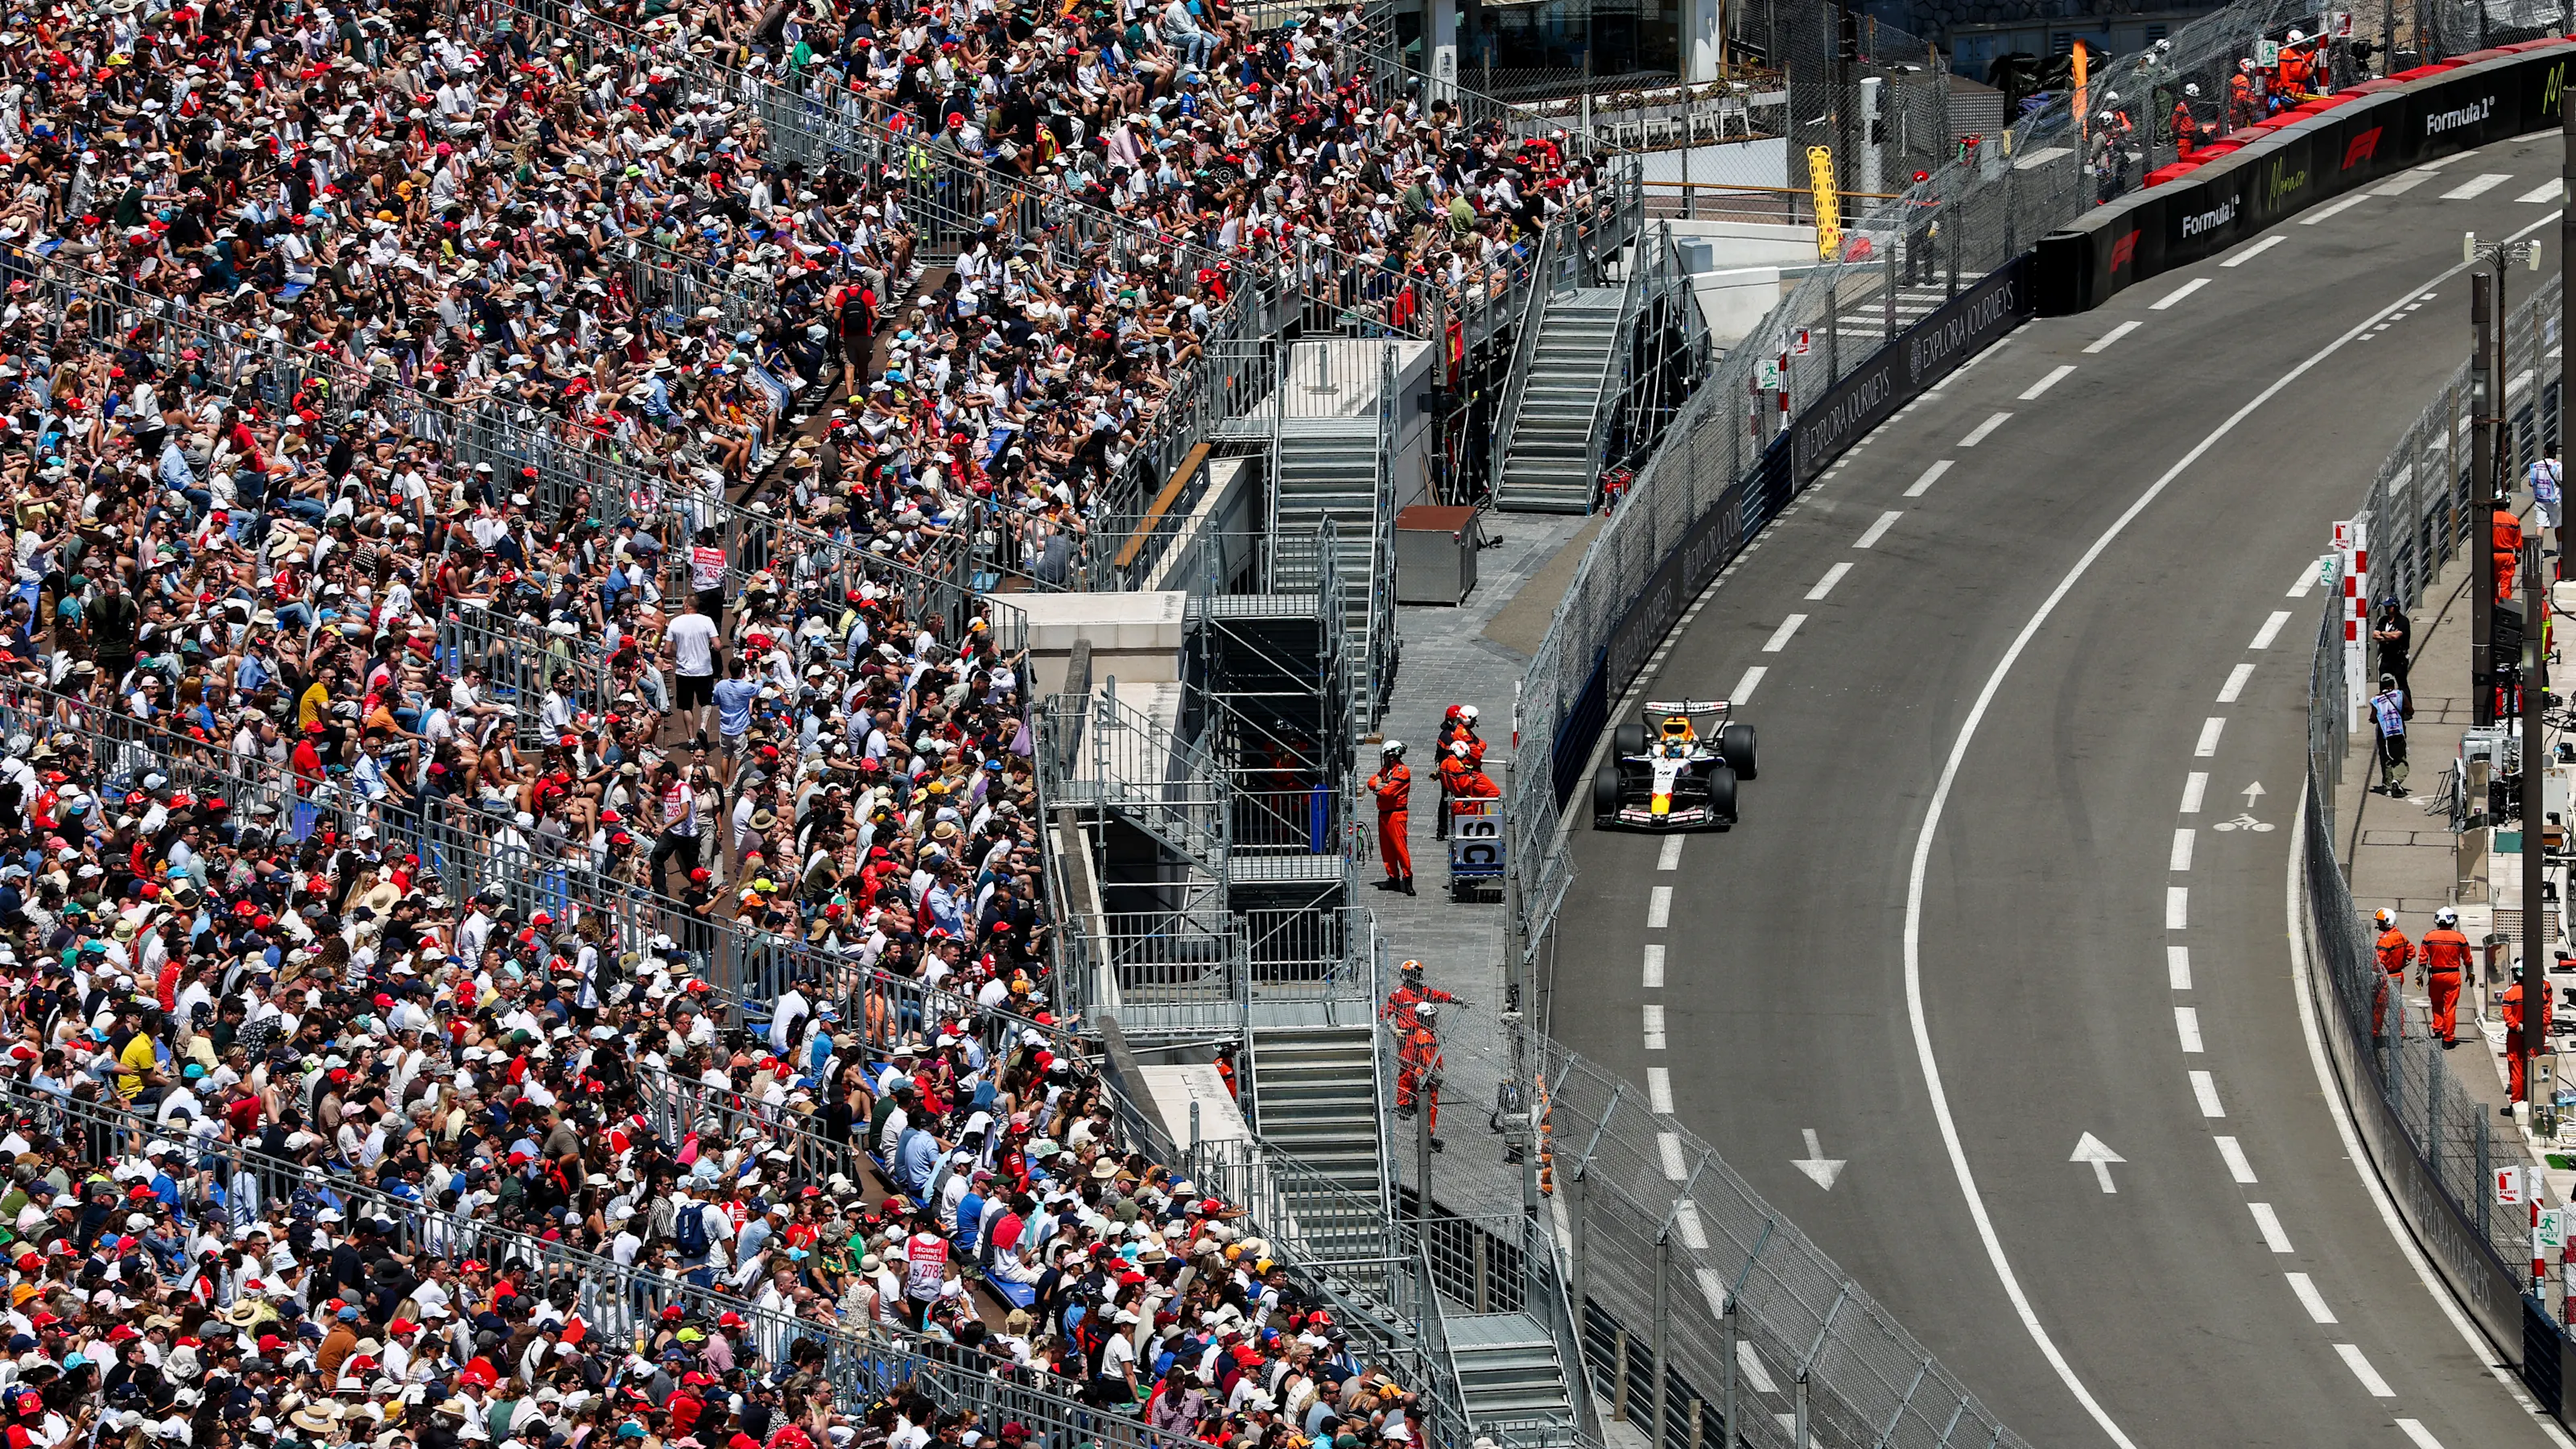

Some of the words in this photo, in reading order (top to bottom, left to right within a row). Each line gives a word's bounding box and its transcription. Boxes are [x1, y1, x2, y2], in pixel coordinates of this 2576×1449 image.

[2426, 101, 2480, 136] Formula
[2268, 156, 2308, 213] Monaco
[2182, 201, 2230, 238] Formula
[1923, 315, 1966, 369] EXPLORA
[1967, 280, 2013, 348] JOURNEYS
[1810, 402, 1847, 459] EXPLORA
[1847, 365, 1890, 435] JOURNEYS
[1691, 522, 1722, 581] EXPLORA
[704, 566, 718, 579] 185
[667, 805, 682, 817] 226
[912, 1253, 943, 1261] CONTRÔE
[2417, 1181, 2450, 1261] EXPLORA
[2450, 1228, 2491, 1311] JOURNEYS
[921, 1264, 939, 1278] 278
